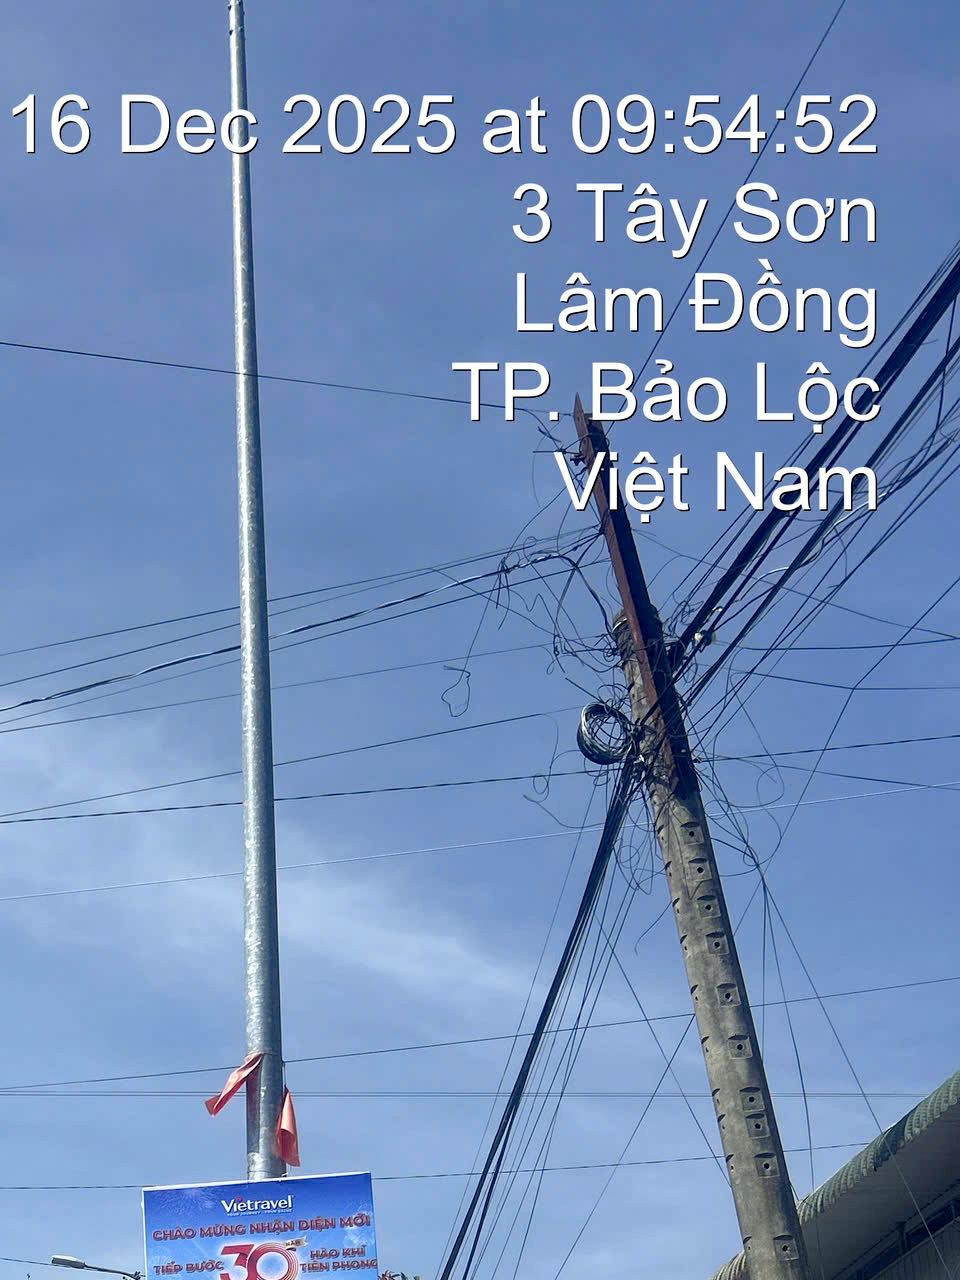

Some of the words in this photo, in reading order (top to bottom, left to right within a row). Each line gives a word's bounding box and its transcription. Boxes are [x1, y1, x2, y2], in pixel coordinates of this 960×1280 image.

[221, 1195, 293, 1213] Vietravel
[153, 1226, 197, 1241] CHÀO
[200, 1223, 246, 1238] MỪNG
[250, 1219, 294, 1235] NHẬN
[299, 1216, 336, 1232] DIỆN
